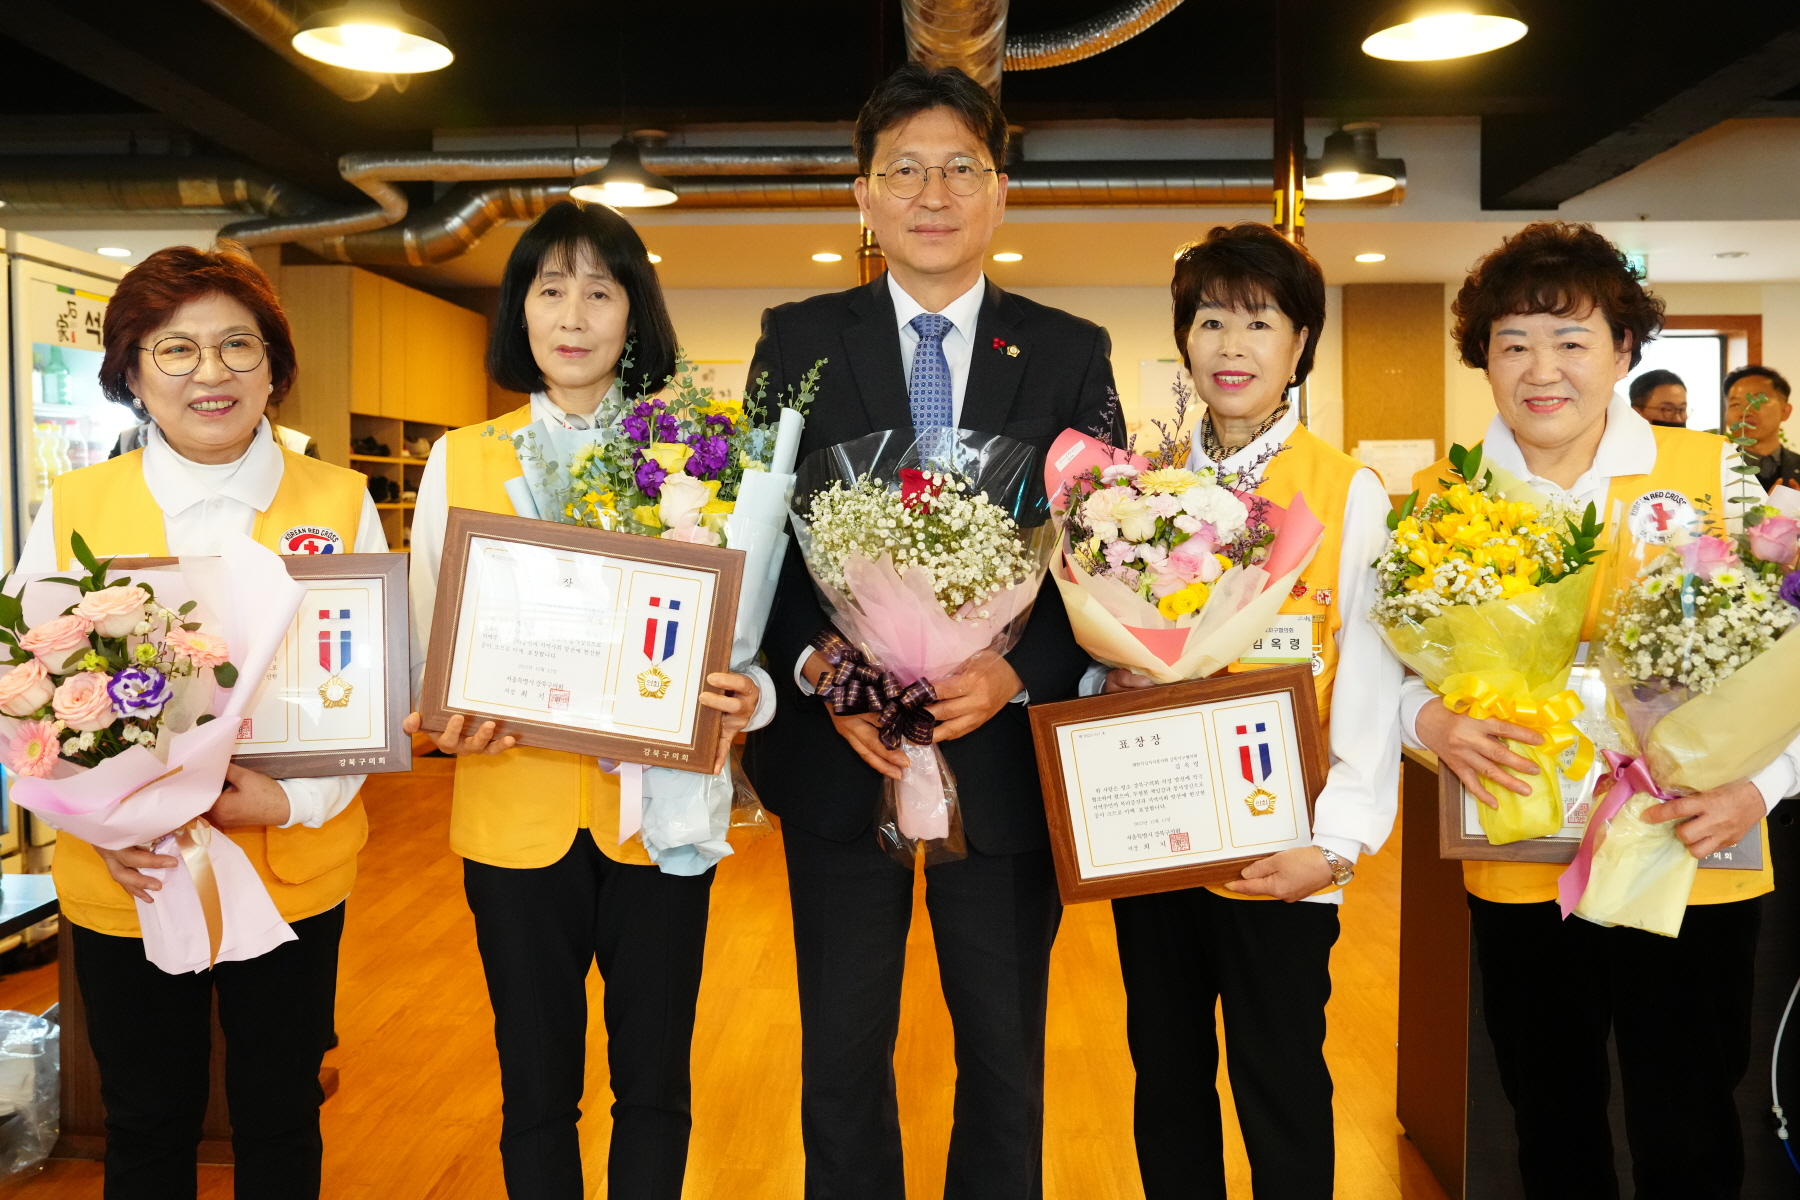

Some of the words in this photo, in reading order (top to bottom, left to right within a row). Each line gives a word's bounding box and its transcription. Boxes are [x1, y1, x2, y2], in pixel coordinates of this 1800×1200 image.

[85, 311, 101, 345] 석
[1650, 491, 1664, 499] RED
[284, 528, 307, 542] KOREAN
[320, 530, 339, 543] CROSS
[507, 676, 534, 686] 서울특별시
[646, 679, 660, 687] 의회
[1119, 734, 1161, 749] 표창장
[643, 747, 689, 762] 강북구의회
[339, 757, 386, 767] 강북구의회
[1256, 799, 1268, 807] 의회
